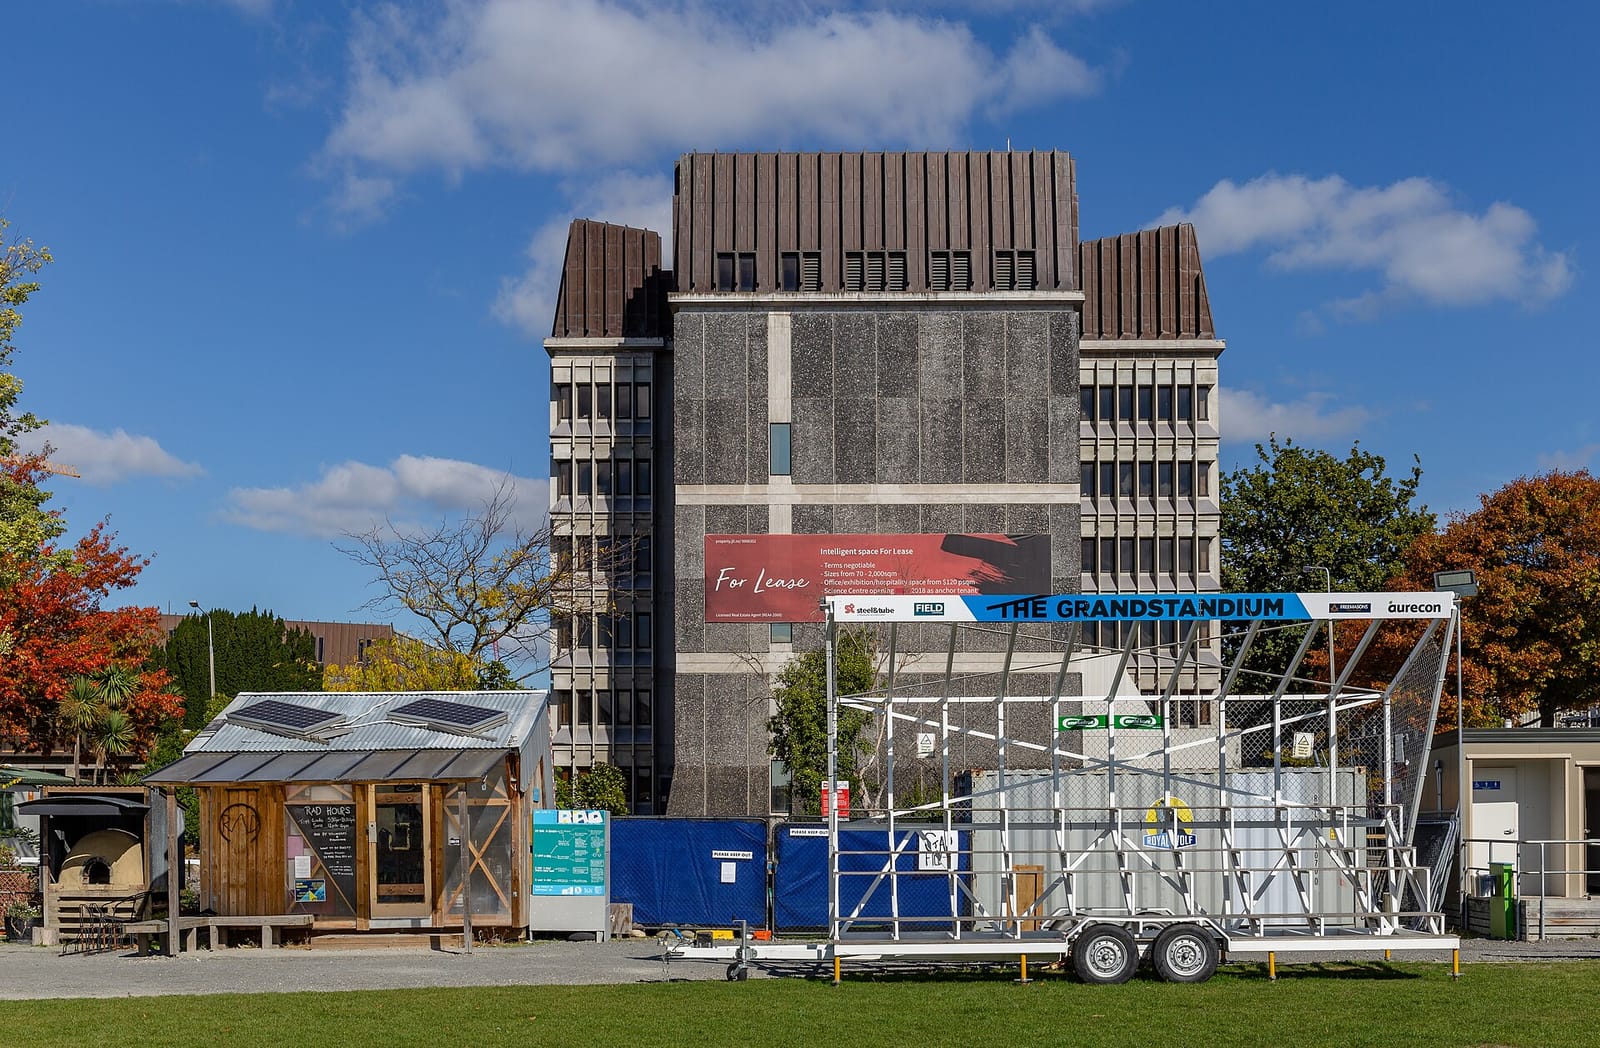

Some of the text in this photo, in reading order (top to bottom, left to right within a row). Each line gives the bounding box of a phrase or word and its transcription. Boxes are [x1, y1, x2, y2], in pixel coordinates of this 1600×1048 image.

[820, 547, 857, 557] Intelligent
[843, 562, 876, 570] negotiable
[868, 570, 898, 578] 2,000sqm
[715, 567, 810, 594] For Lease
[824, 579, 908, 587] Office/exhibition/hospitality
[942, 578, 958, 586] $120
[856, 606, 895, 614] steel&tube
[915, 603, 943, 613] FIELD
[986, 595, 1284, 618] THE GRANDSTANDIUM
[1387, 601, 1441, 613] aurecon
[304, 806, 351, 816] RAD HOURS
[558, 810, 603, 824] RAD
[1146, 834, 1170, 848] ROYAL
